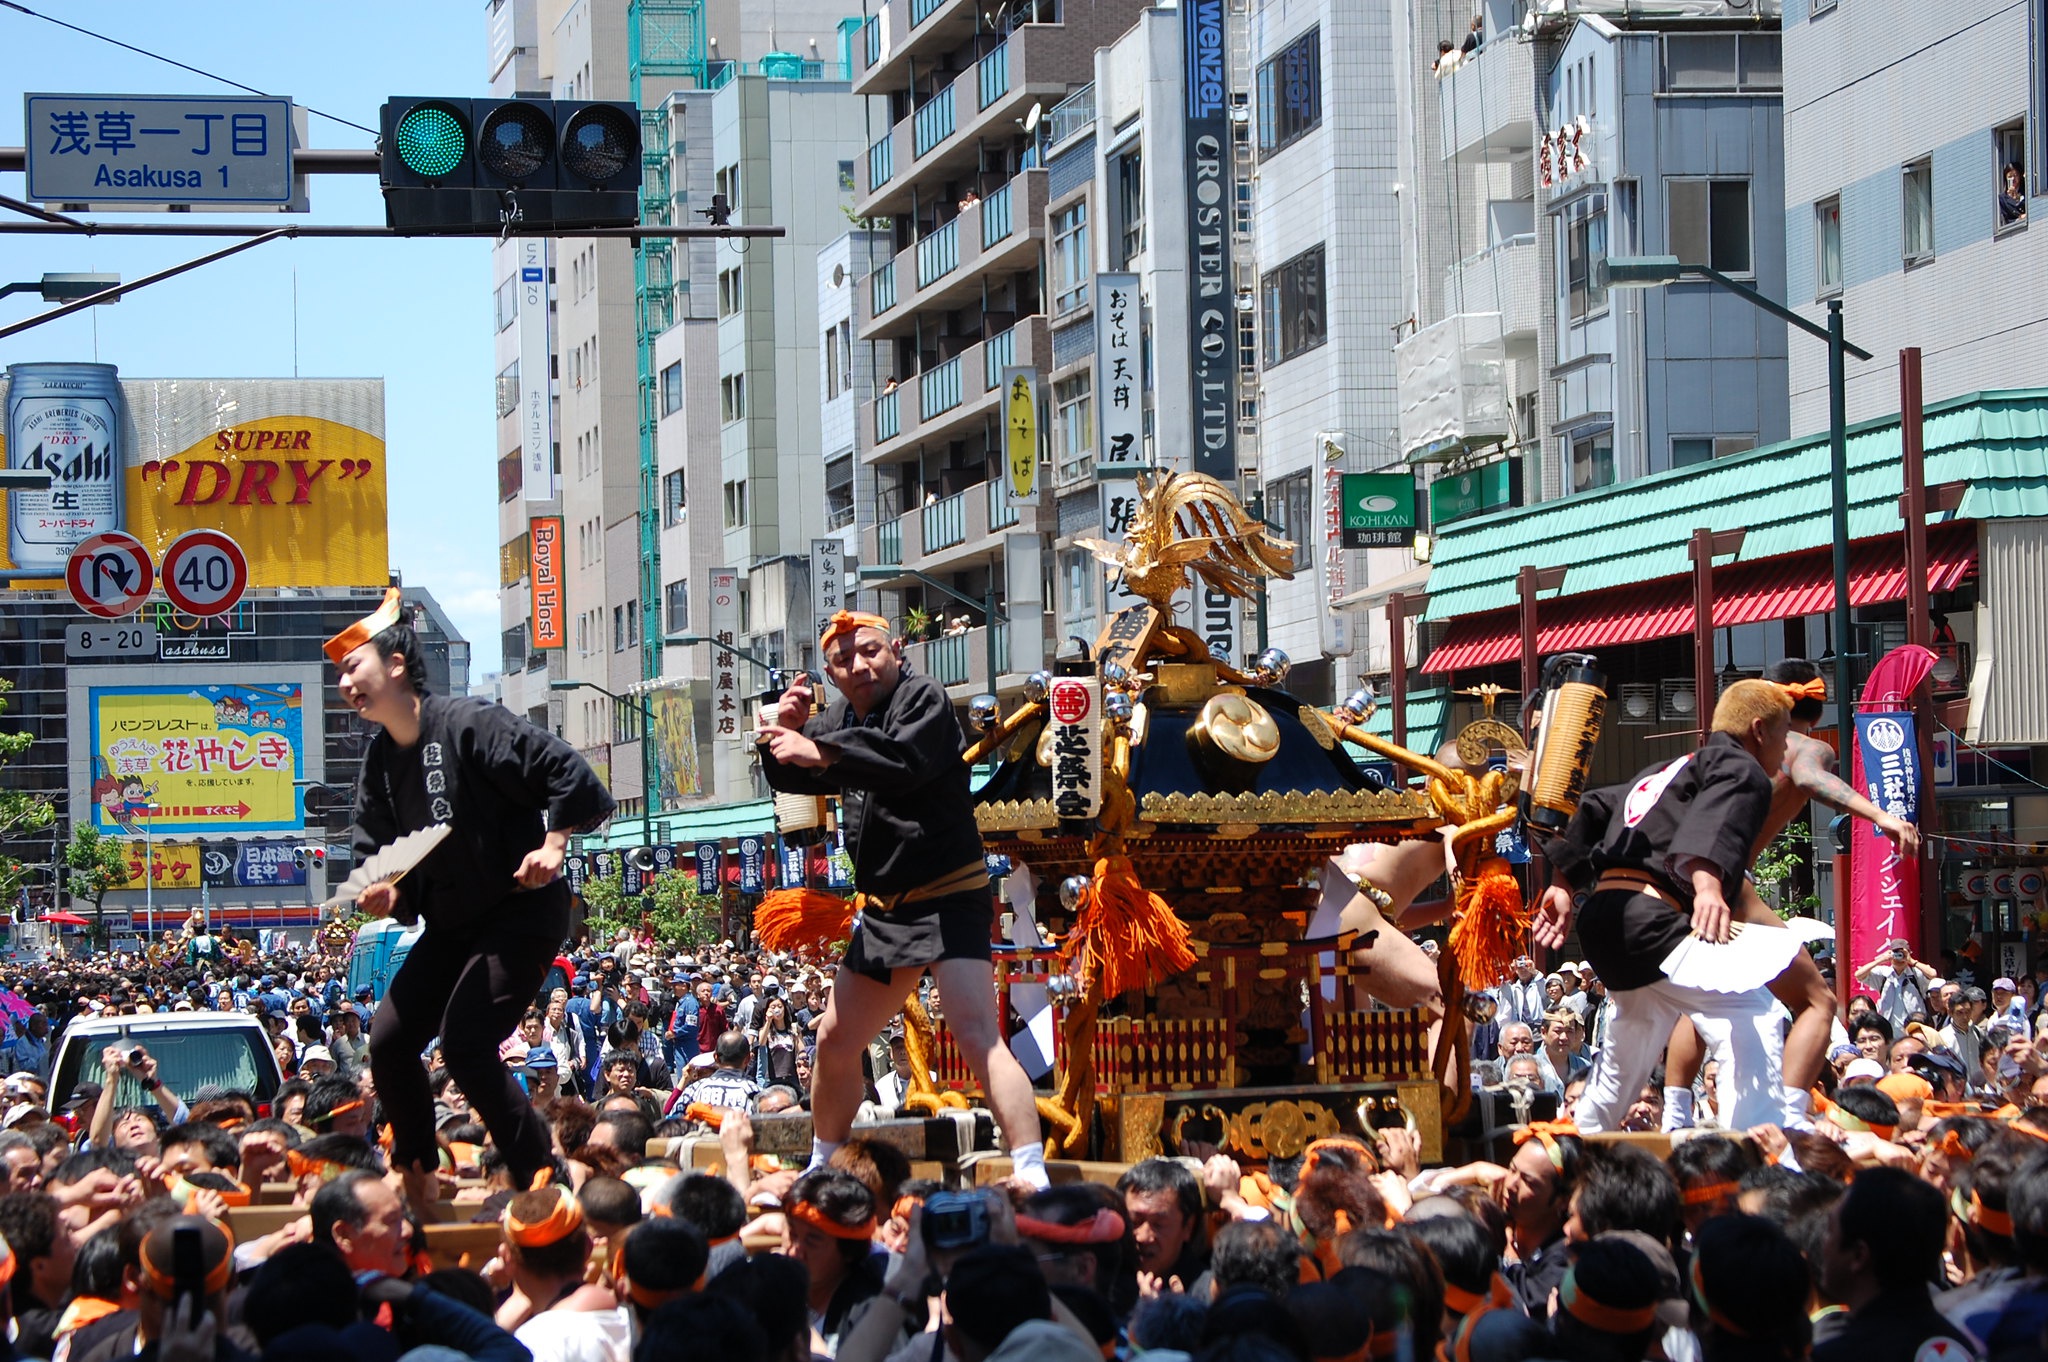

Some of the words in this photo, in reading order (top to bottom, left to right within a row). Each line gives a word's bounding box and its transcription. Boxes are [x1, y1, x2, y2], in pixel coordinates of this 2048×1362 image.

[50, 111, 267, 157] 浅草一丁目
[94, 164, 202, 188] Asakusa
[218, 165, 229, 188] 1
[1195, 135, 1223, 297] CROSTER
[44, 407, 79, 418] BREWERIES
[1012, 380, 1032, 477] おそば
[214, 429, 312, 451] SUPER
[20, 442, 111, 482] Asahi
[52, 490, 80, 510] 生
[39, 519, 95, 528] スーパードライ
[1357, 531, 1402, 544] 珈琲館
[536, 525, 556, 586] Royal
[179, 555, 228, 592] 40
[713, 575, 735, 606] 酒の
[537, 590, 557, 641] Host
[165, 642, 226, 656] asakusa
[716, 629, 736, 735] 相模屋本店
[118, 757, 150, 773] 浅草
[160, 737, 288, 772] 花やしき
[1881, 754, 1907, 821] 三社祭
[129, 860, 192, 881] ラオケ
[245, 847, 294, 863] 日本海
